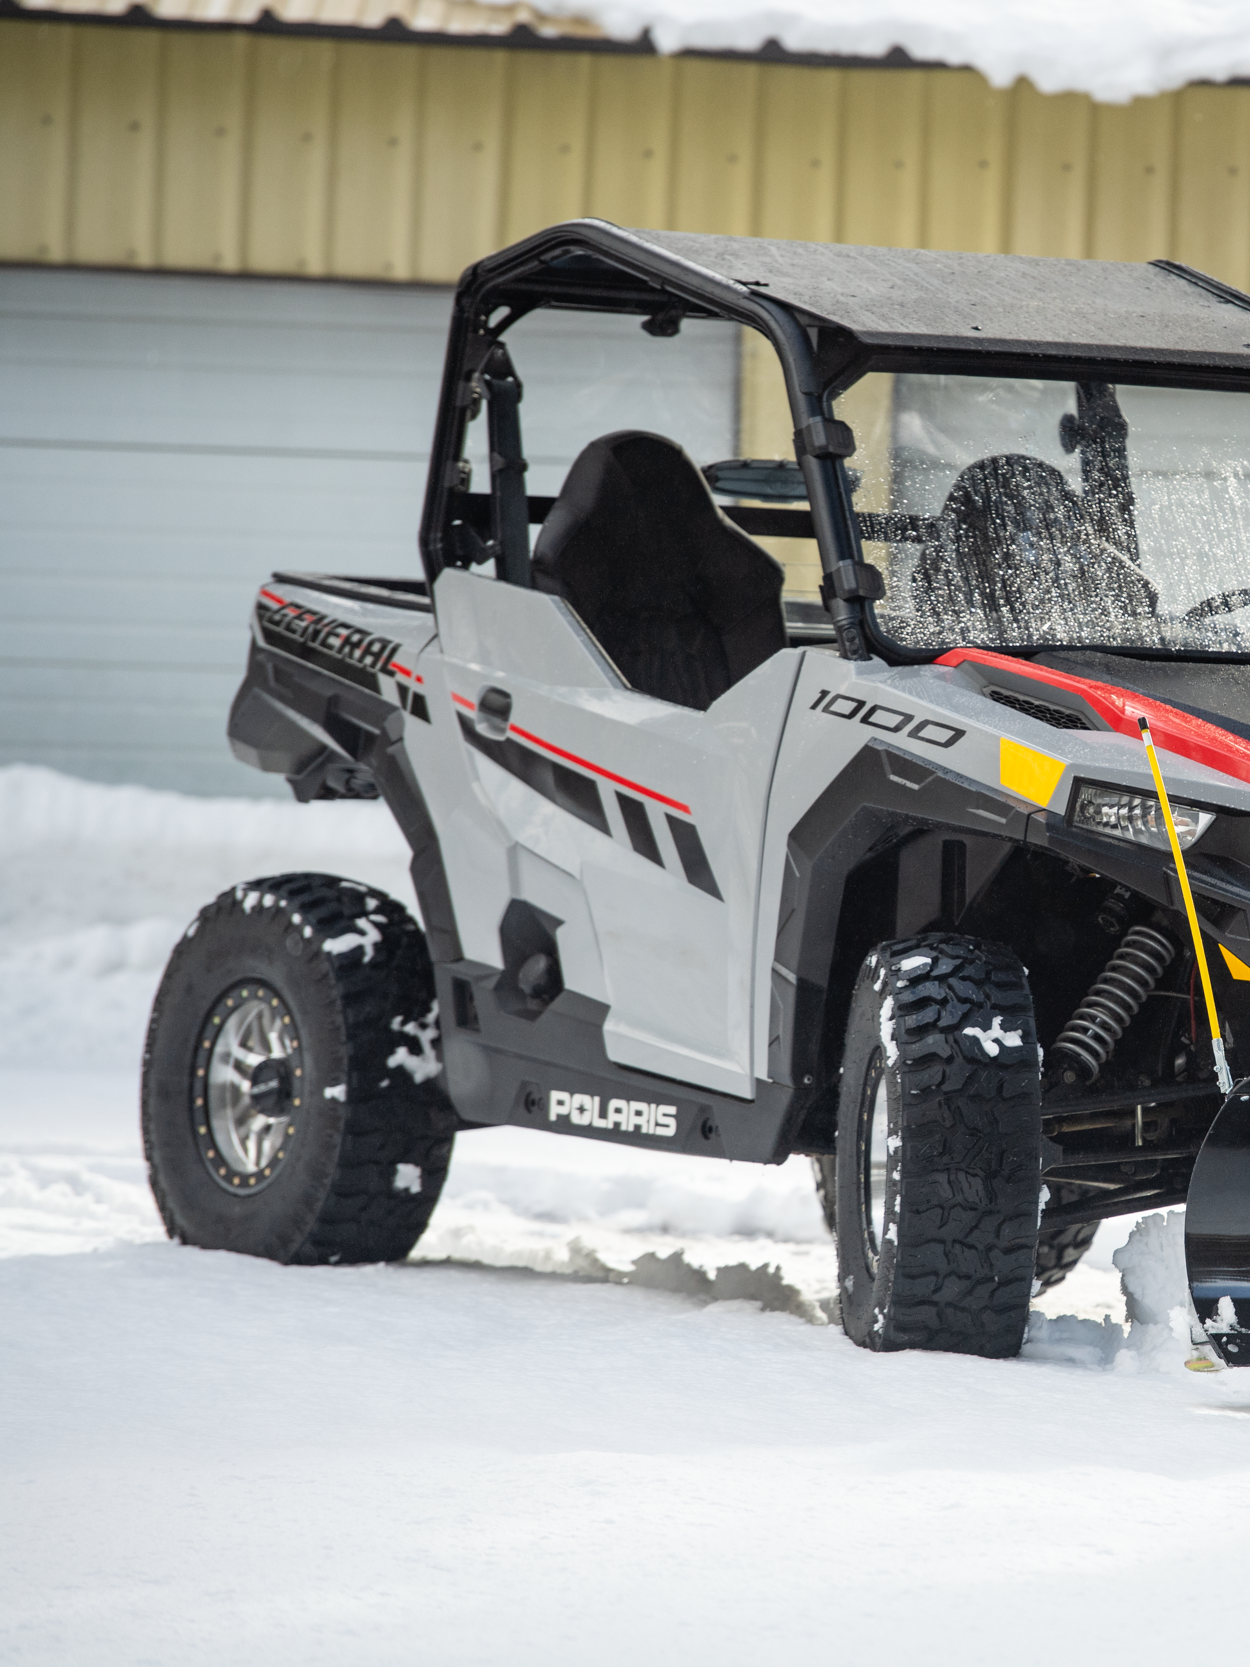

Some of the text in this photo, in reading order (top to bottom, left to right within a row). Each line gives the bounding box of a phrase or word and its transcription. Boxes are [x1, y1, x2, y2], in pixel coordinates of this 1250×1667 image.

[263, 601, 403, 678] GENERAL
[809, 689, 967, 749] 1000
[549, 1089, 677, 1137] POLARIS
